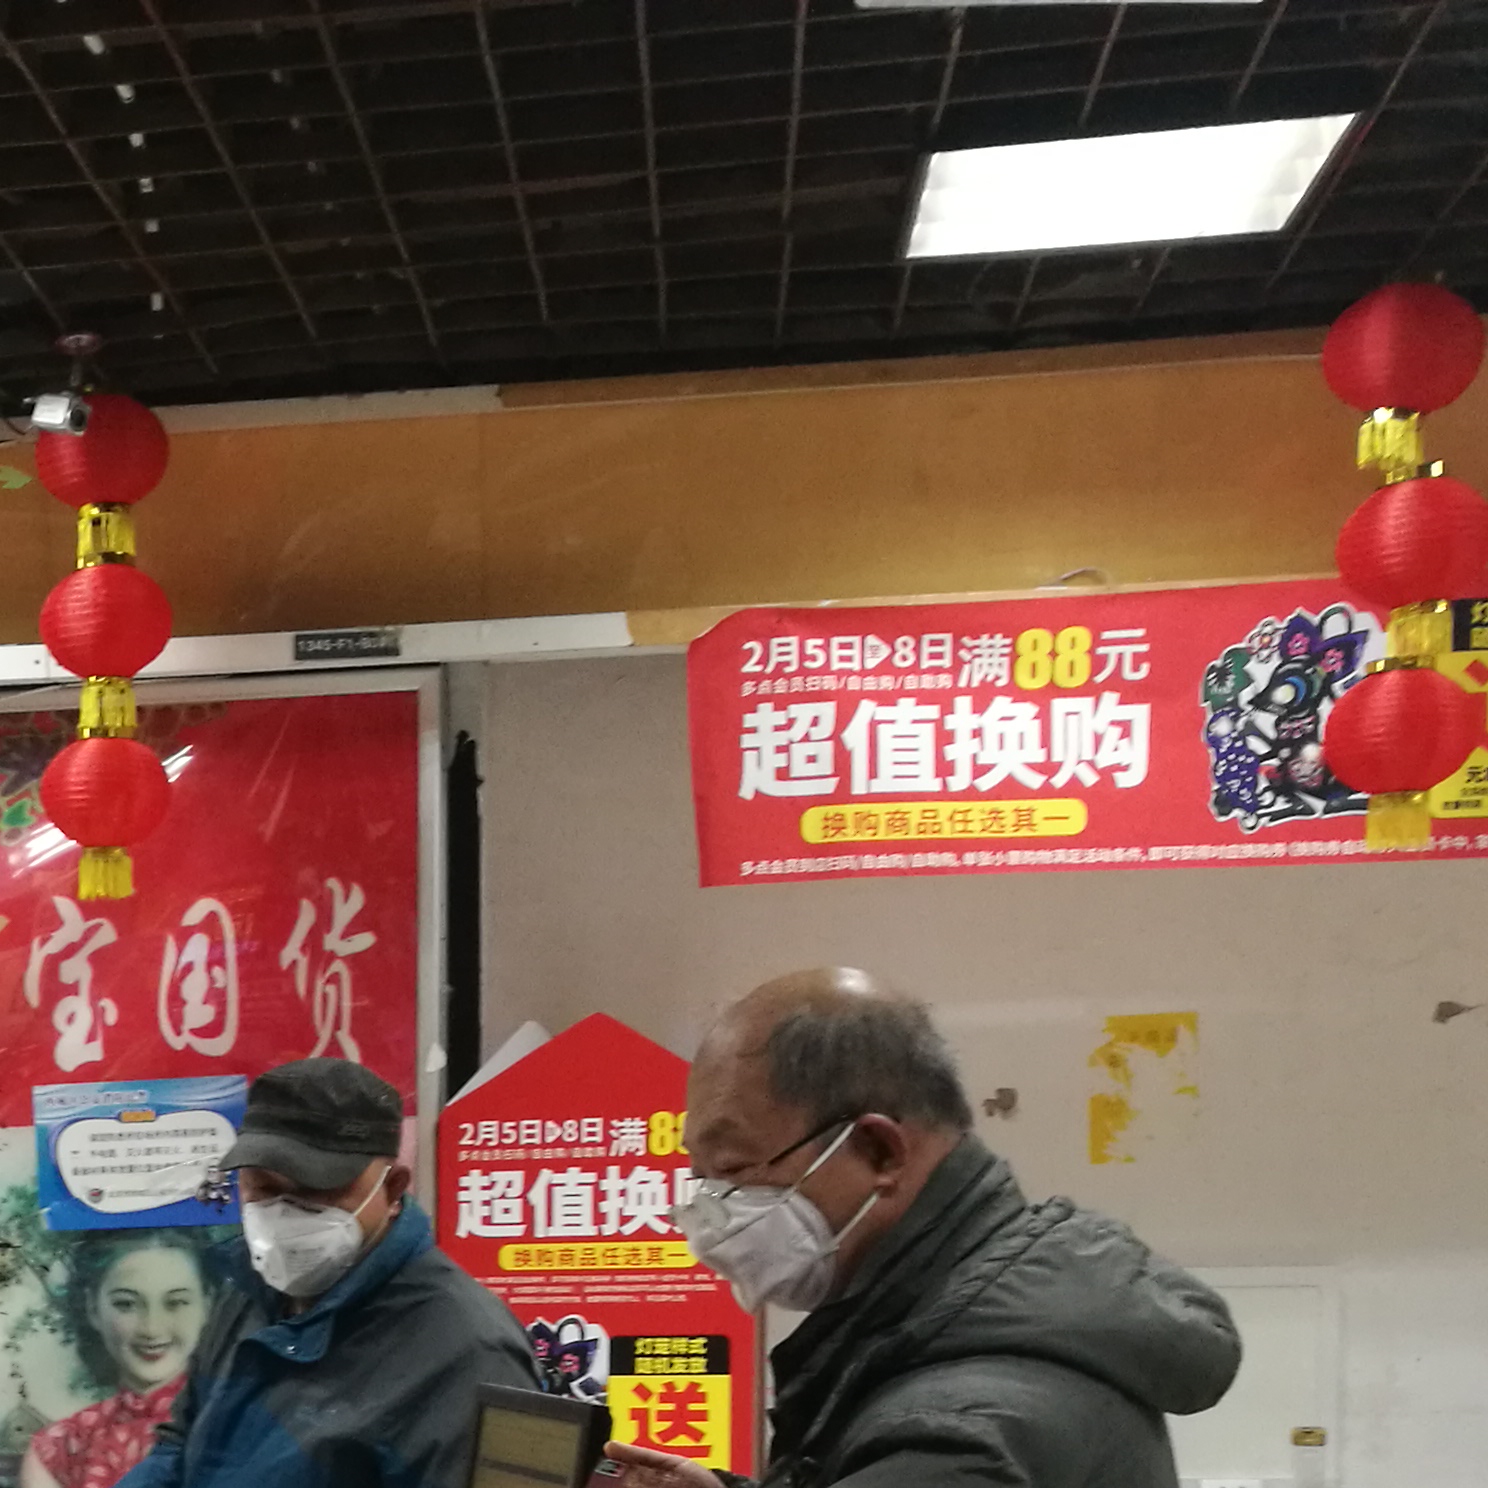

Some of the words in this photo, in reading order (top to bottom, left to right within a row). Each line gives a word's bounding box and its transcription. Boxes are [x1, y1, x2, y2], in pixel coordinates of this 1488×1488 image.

[957, 625, 1150, 691] 满88元
[737, 690, 1152, 800] 超值换购
[821, 806, 1070, 840] 换购商品任选其一
[630, 1381, 711, 1458] 送
